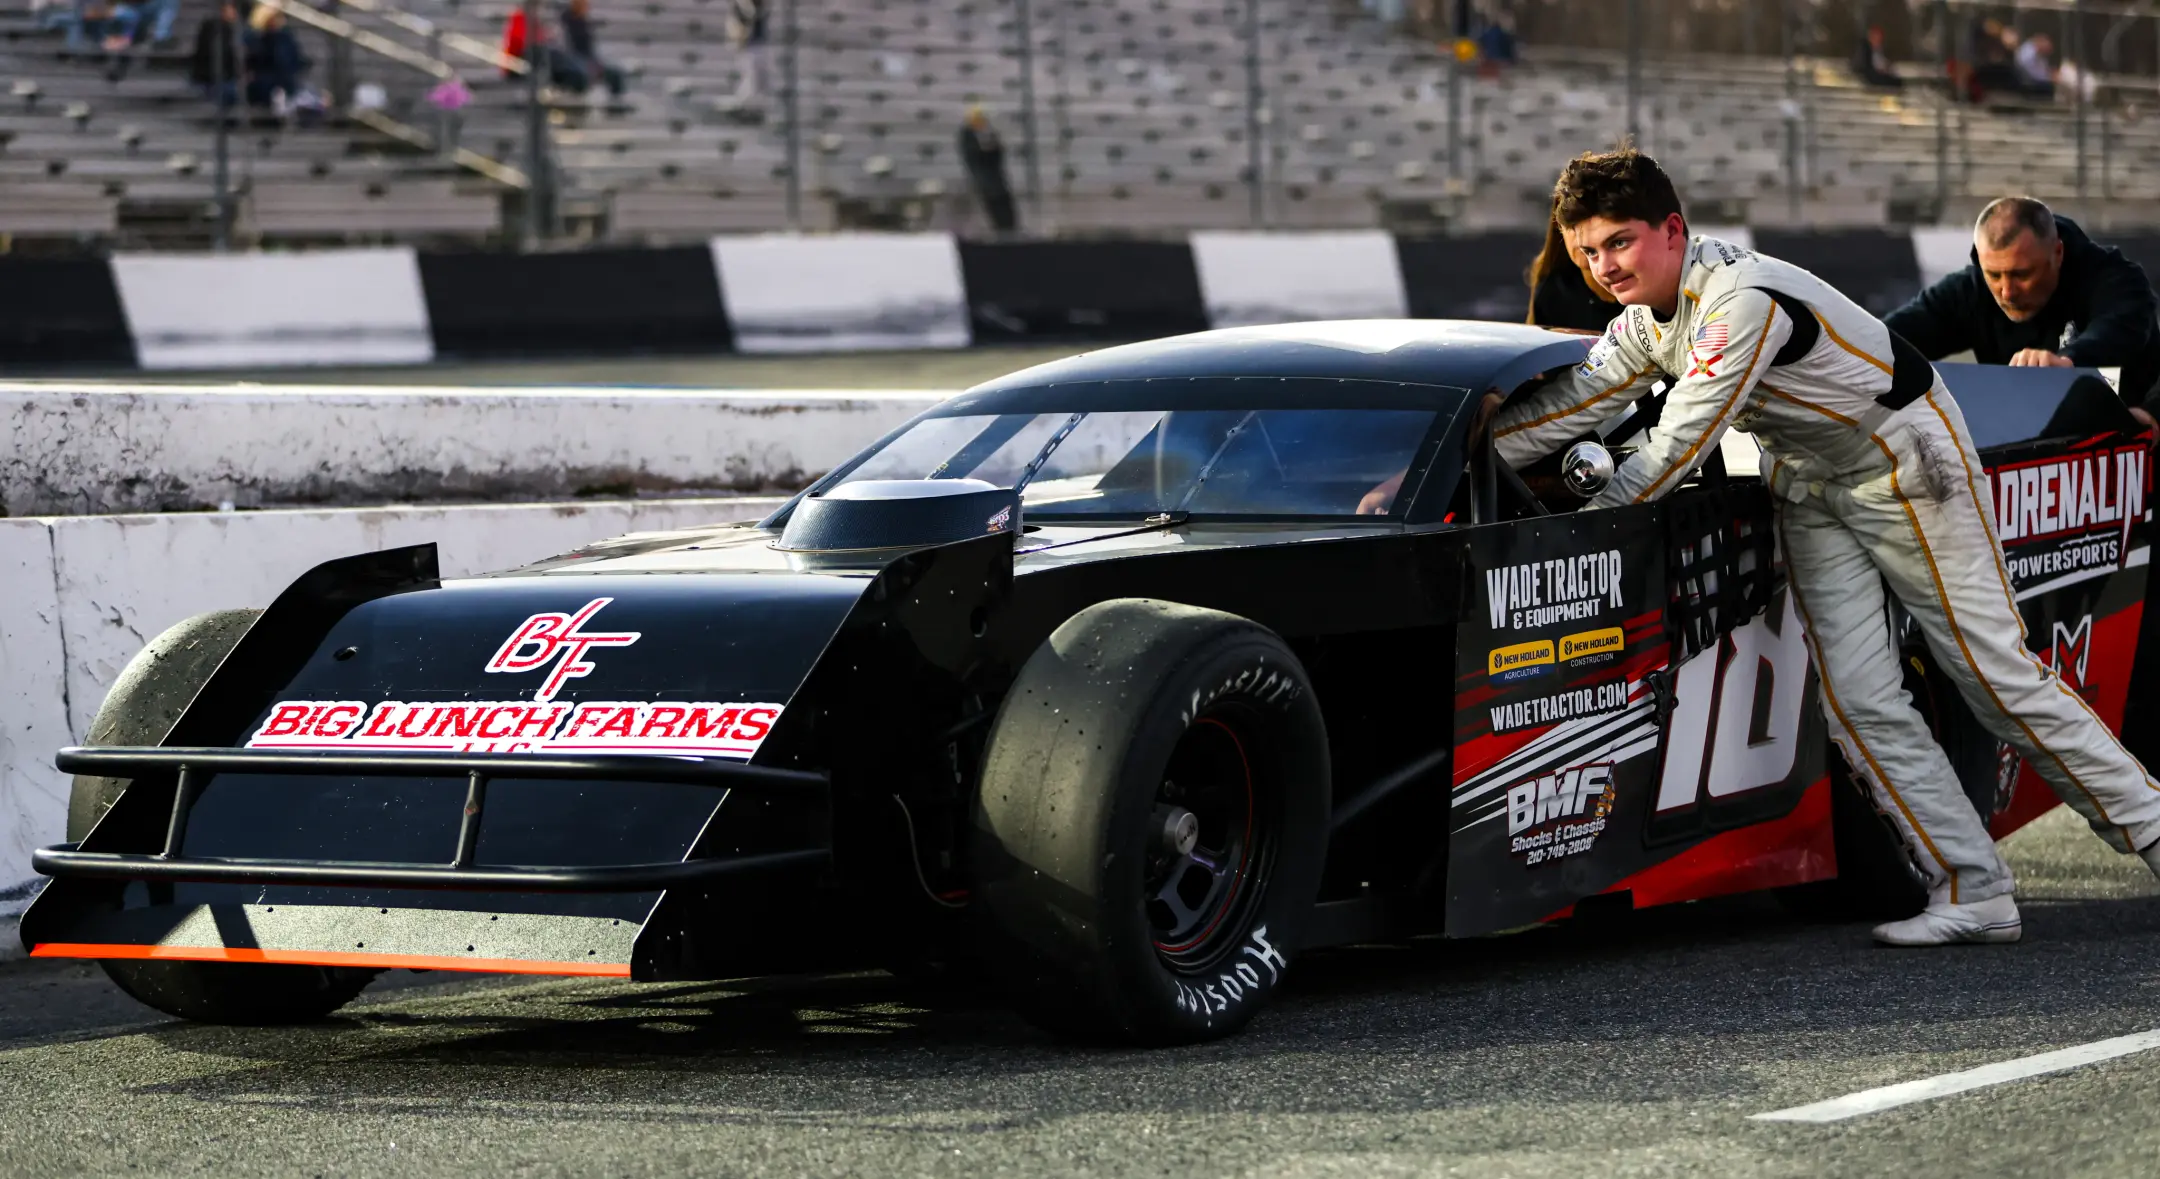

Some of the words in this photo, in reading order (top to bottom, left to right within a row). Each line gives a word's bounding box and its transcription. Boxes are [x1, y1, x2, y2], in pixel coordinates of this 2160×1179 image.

[1633, 307, 1653, 353] sparco
[1985, 450, 2145, 557] DRENALIN
[2008, 540, 2118, 579] POWERSPORTS
[1486, 562, 1540, 629] WADE
[1545, 550, 1623, 608] TRACTOR
[1513, 611, 1523, 630] &
[1526, 599, 1600, 627] EQUIPMENT
[1504, 655, 1519, 665] NEW
[1520, 648, 1550, 662] HOLLAND
[1570, 653, 1614, 667] CONSTRUCTION
[1574, 642, 1588, 652] NEW
[1590, 635, 1619, 649] HOLLAND
[1504, 667, 1540, 680] AGRICULTURE
[259, 706, 359, 738] BIG
[361, 706, 565, 738] LUNCH
[563, 706, 777, 740] FARMS
[1491, 681, 1627, 732] WADETRACTOR.COM
[1508, 766, 1610, 837] BMF
[1511, 831, 1553, 852] Shocks
[1563, 817, 1606, 840] Chassis
